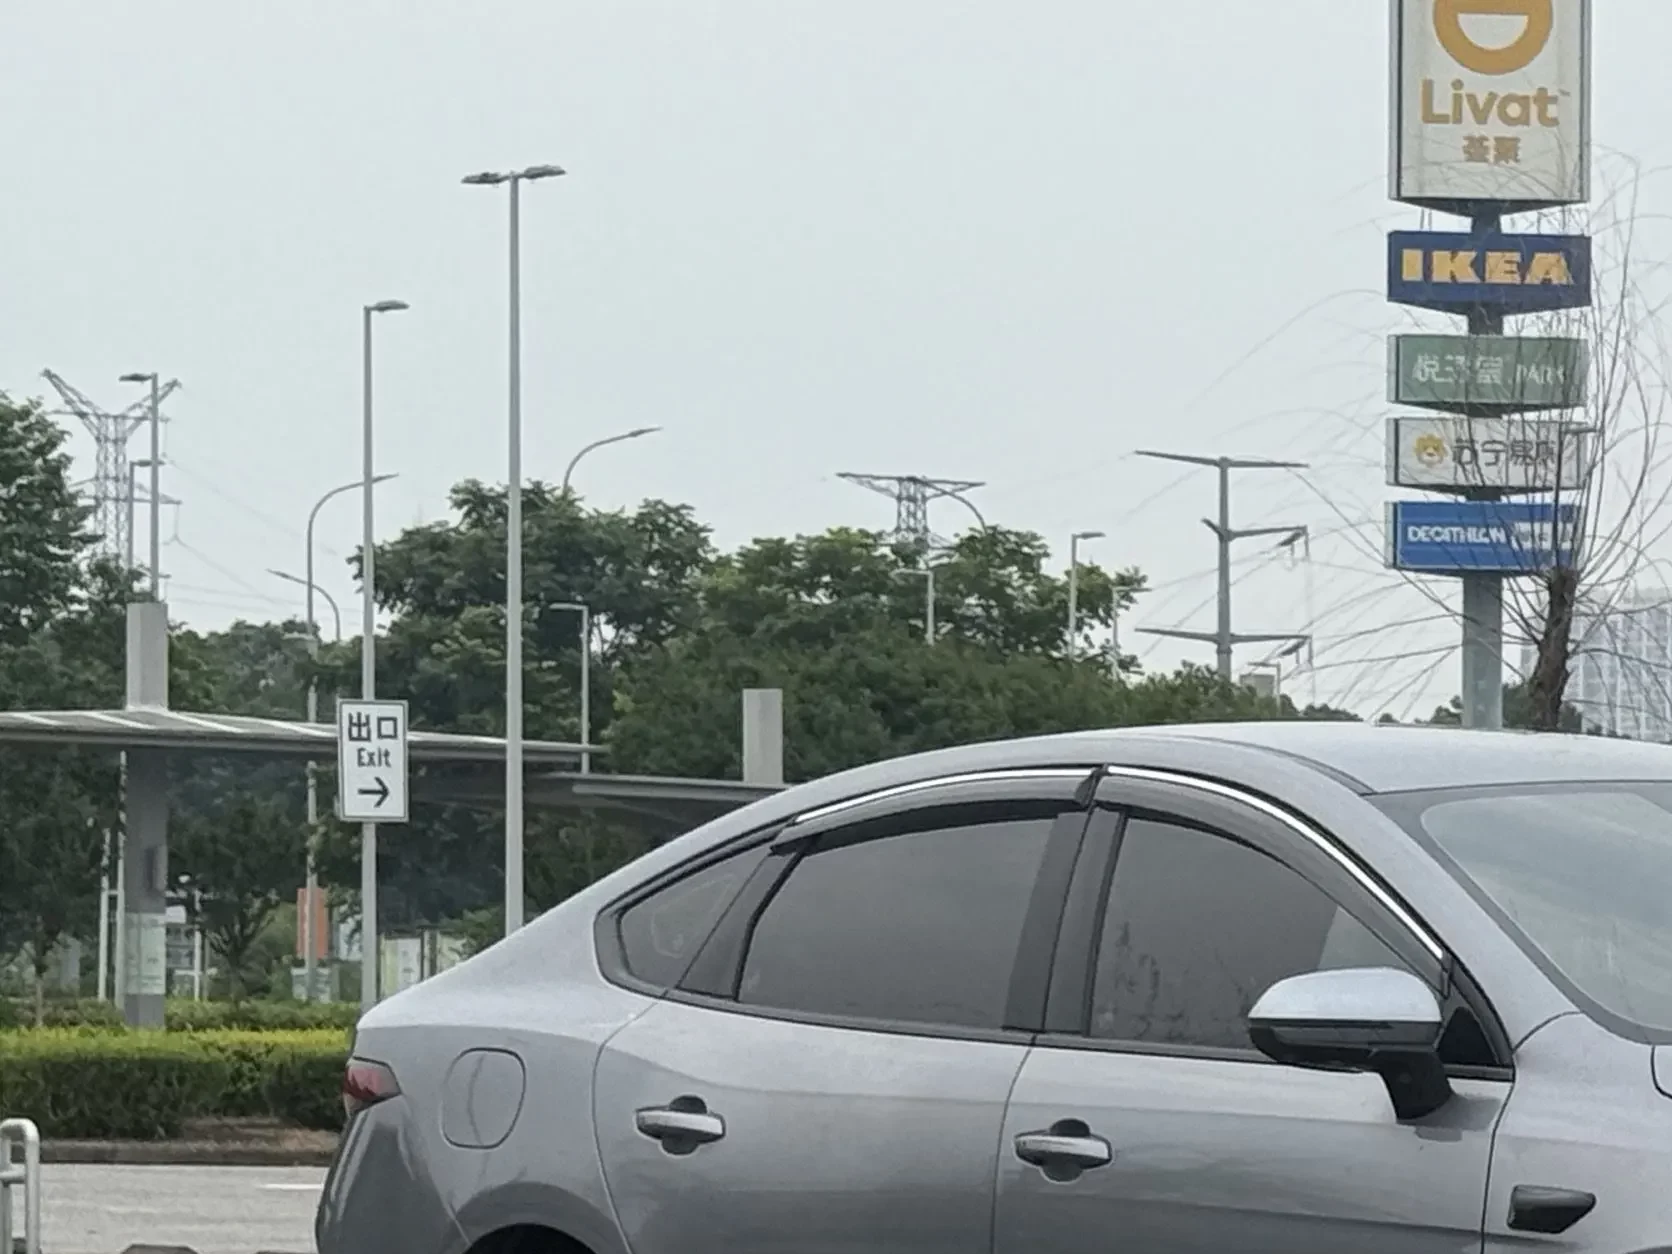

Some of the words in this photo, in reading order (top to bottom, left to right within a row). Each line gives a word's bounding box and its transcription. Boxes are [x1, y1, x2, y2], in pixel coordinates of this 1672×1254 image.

[1420, 78, 1560, 127] Livat
[1401, 248, 1575, 285] IKEA
[1407, 526, 1506, 544] DECATHLON
[348, 711, 398, 742] 出口
[357, 747, 391, 768] Exit
